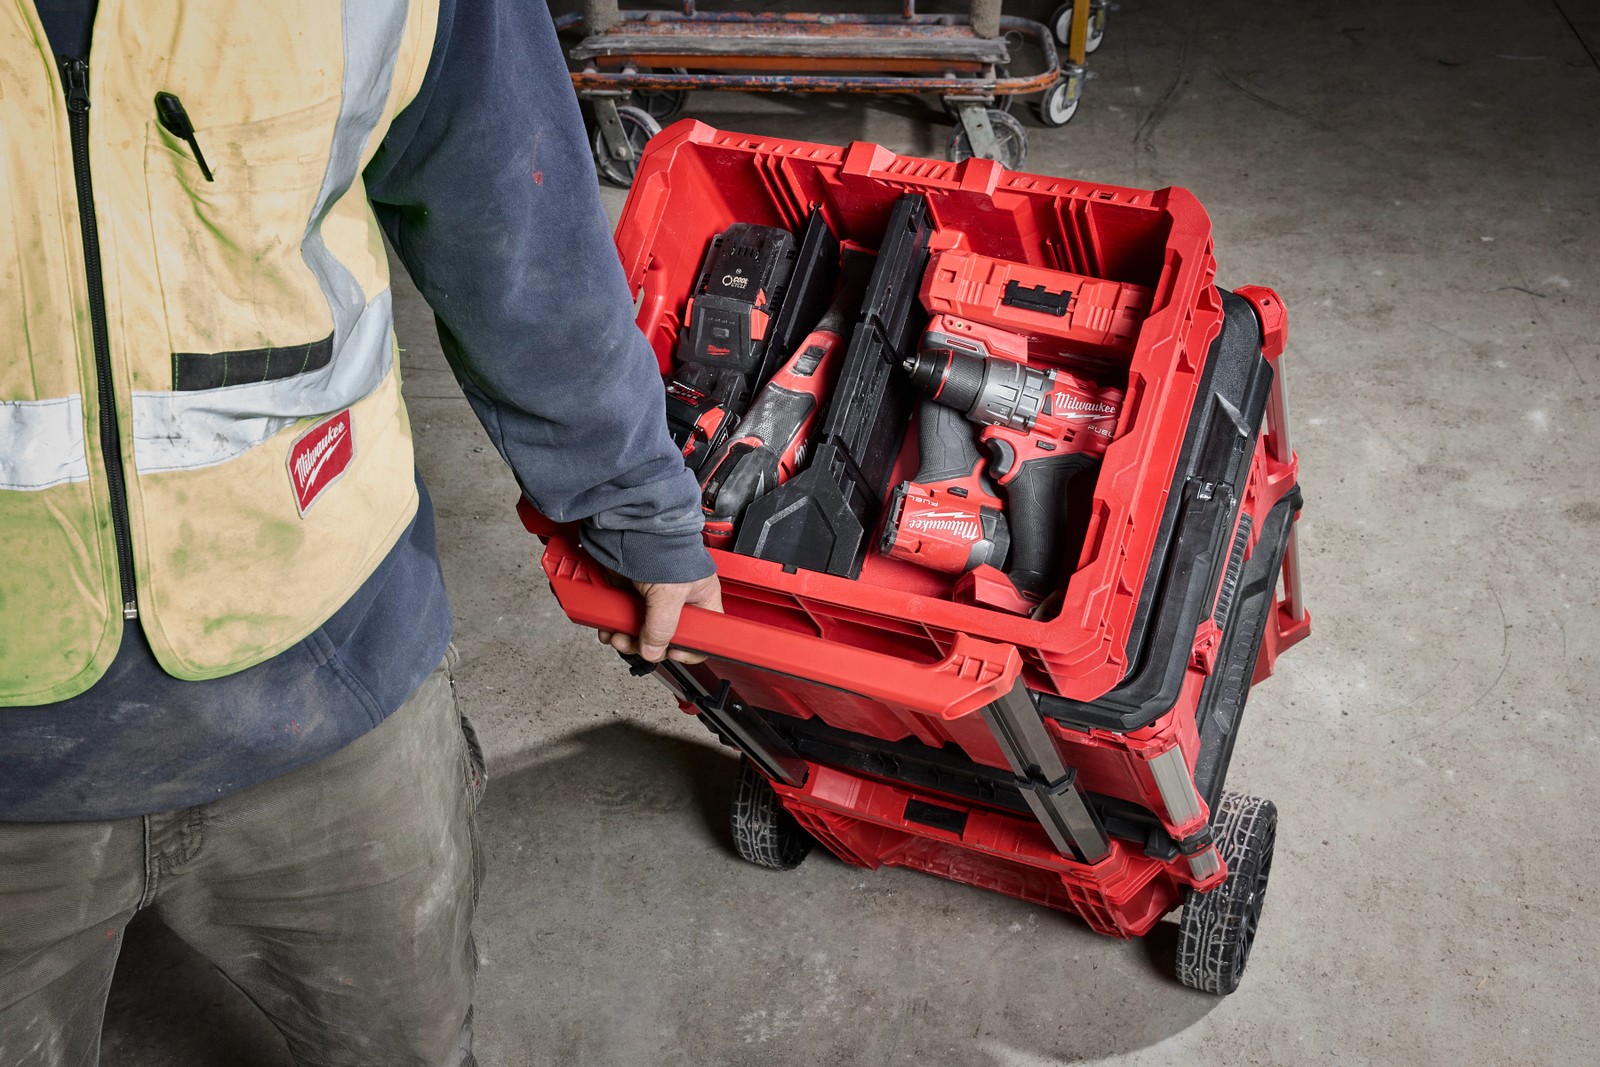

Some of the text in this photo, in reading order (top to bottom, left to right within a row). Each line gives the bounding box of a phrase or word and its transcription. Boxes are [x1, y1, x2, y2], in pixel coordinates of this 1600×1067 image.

[1054, 391, 1116, 413] Milwaukee
[1087, 425, 1113, 438] FUEL
[294, 421, 346, 489] Milwaukee
[908, 494, 938, 507] FUEL
[908, 519, 979, 540] Milwaukee
